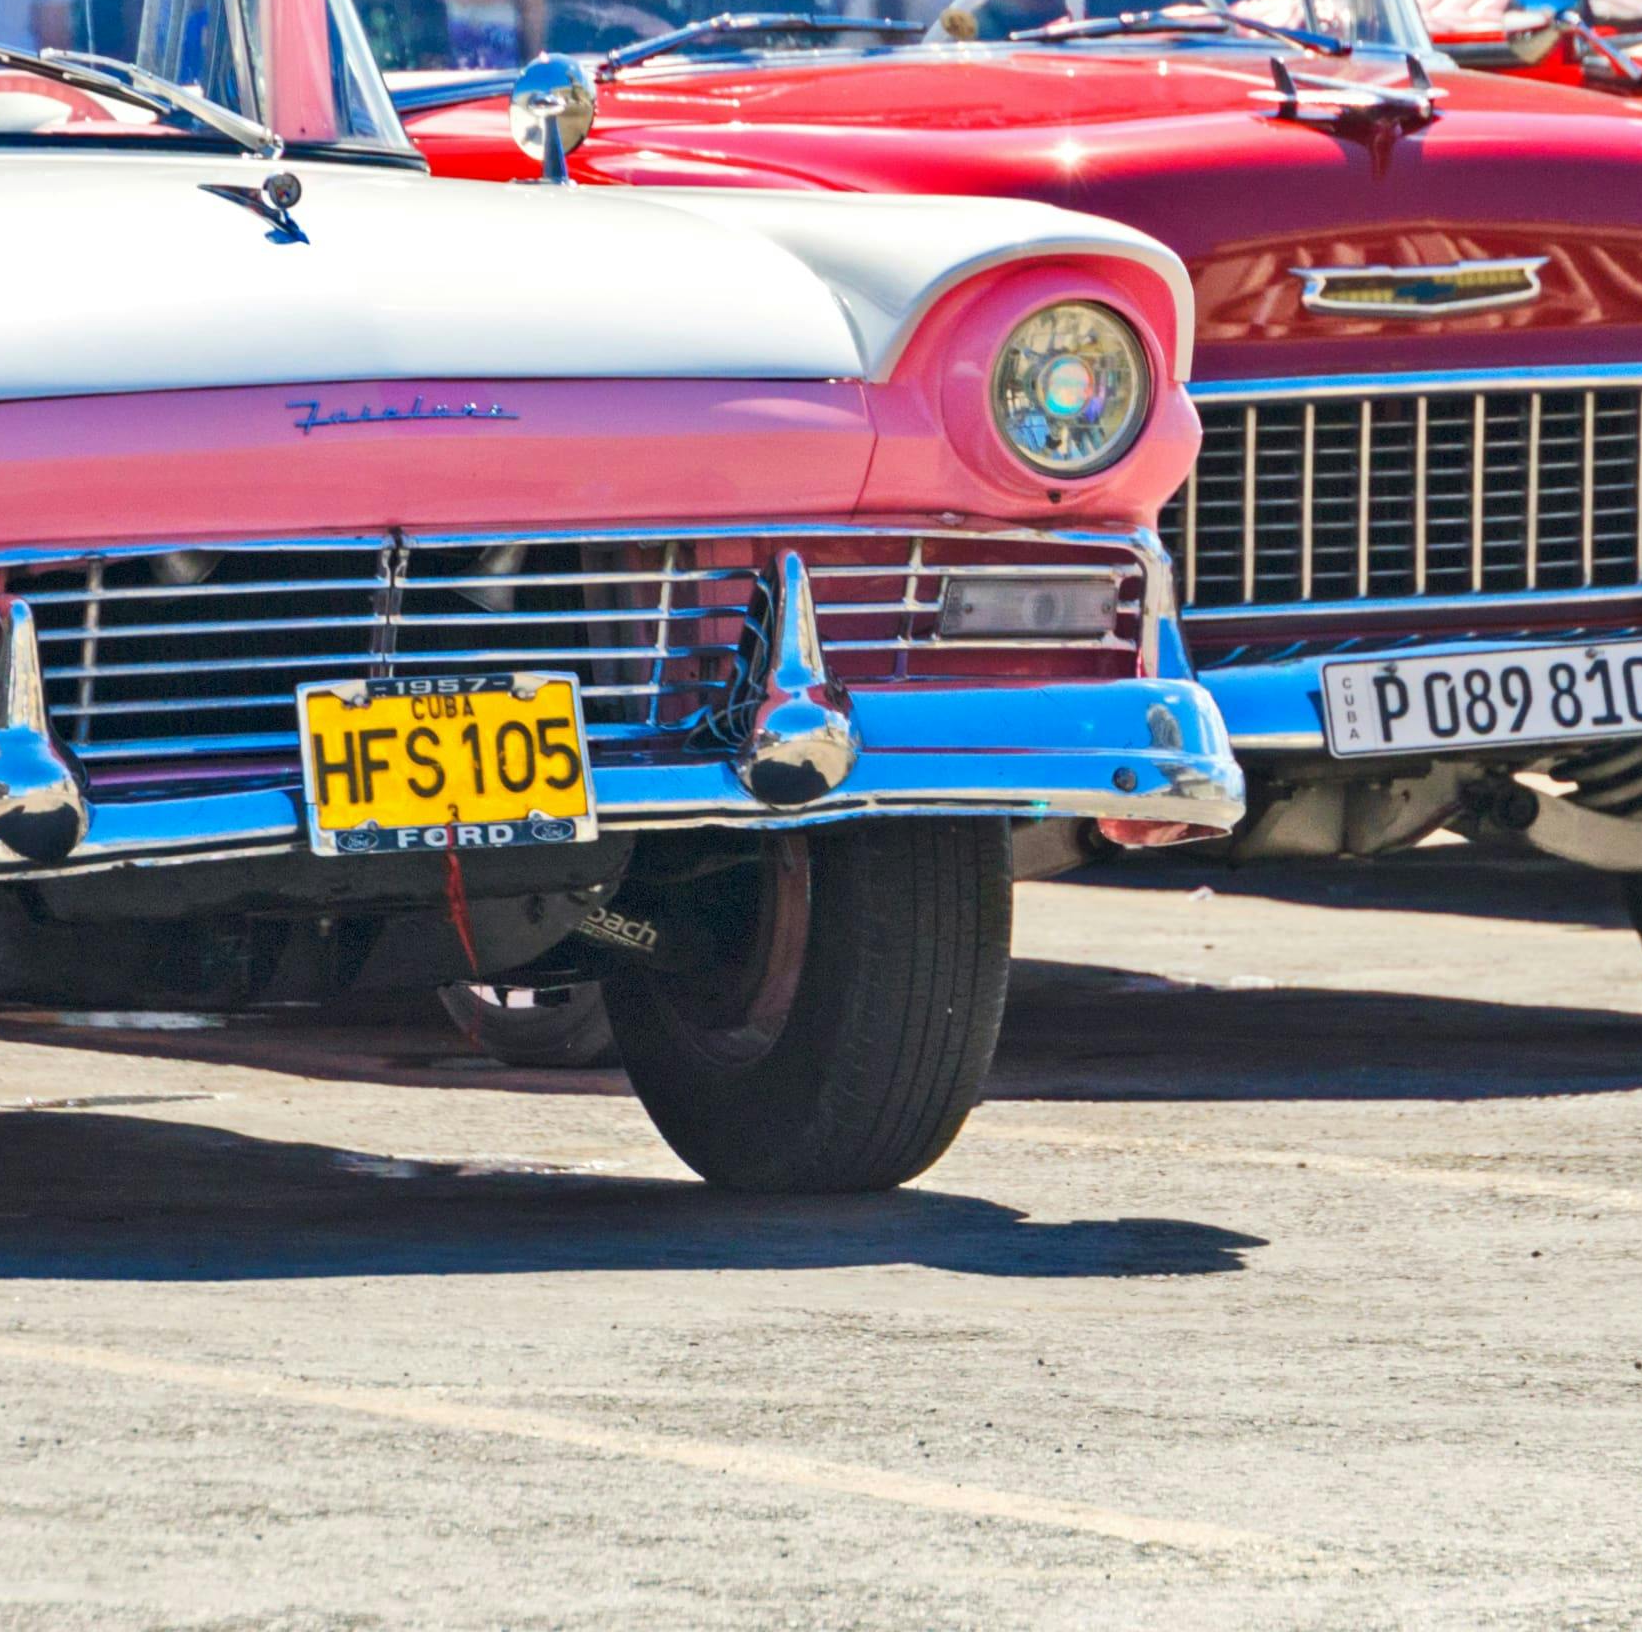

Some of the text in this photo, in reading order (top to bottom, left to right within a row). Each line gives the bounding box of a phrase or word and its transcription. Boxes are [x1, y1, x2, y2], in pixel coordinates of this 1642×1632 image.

[410, 695, 476, 721] CUBA
[1341, 677, 1361, 742] CUBA
[312, 716, 583, 806] HFS 105
[396, 824, 515, 849] FORD
